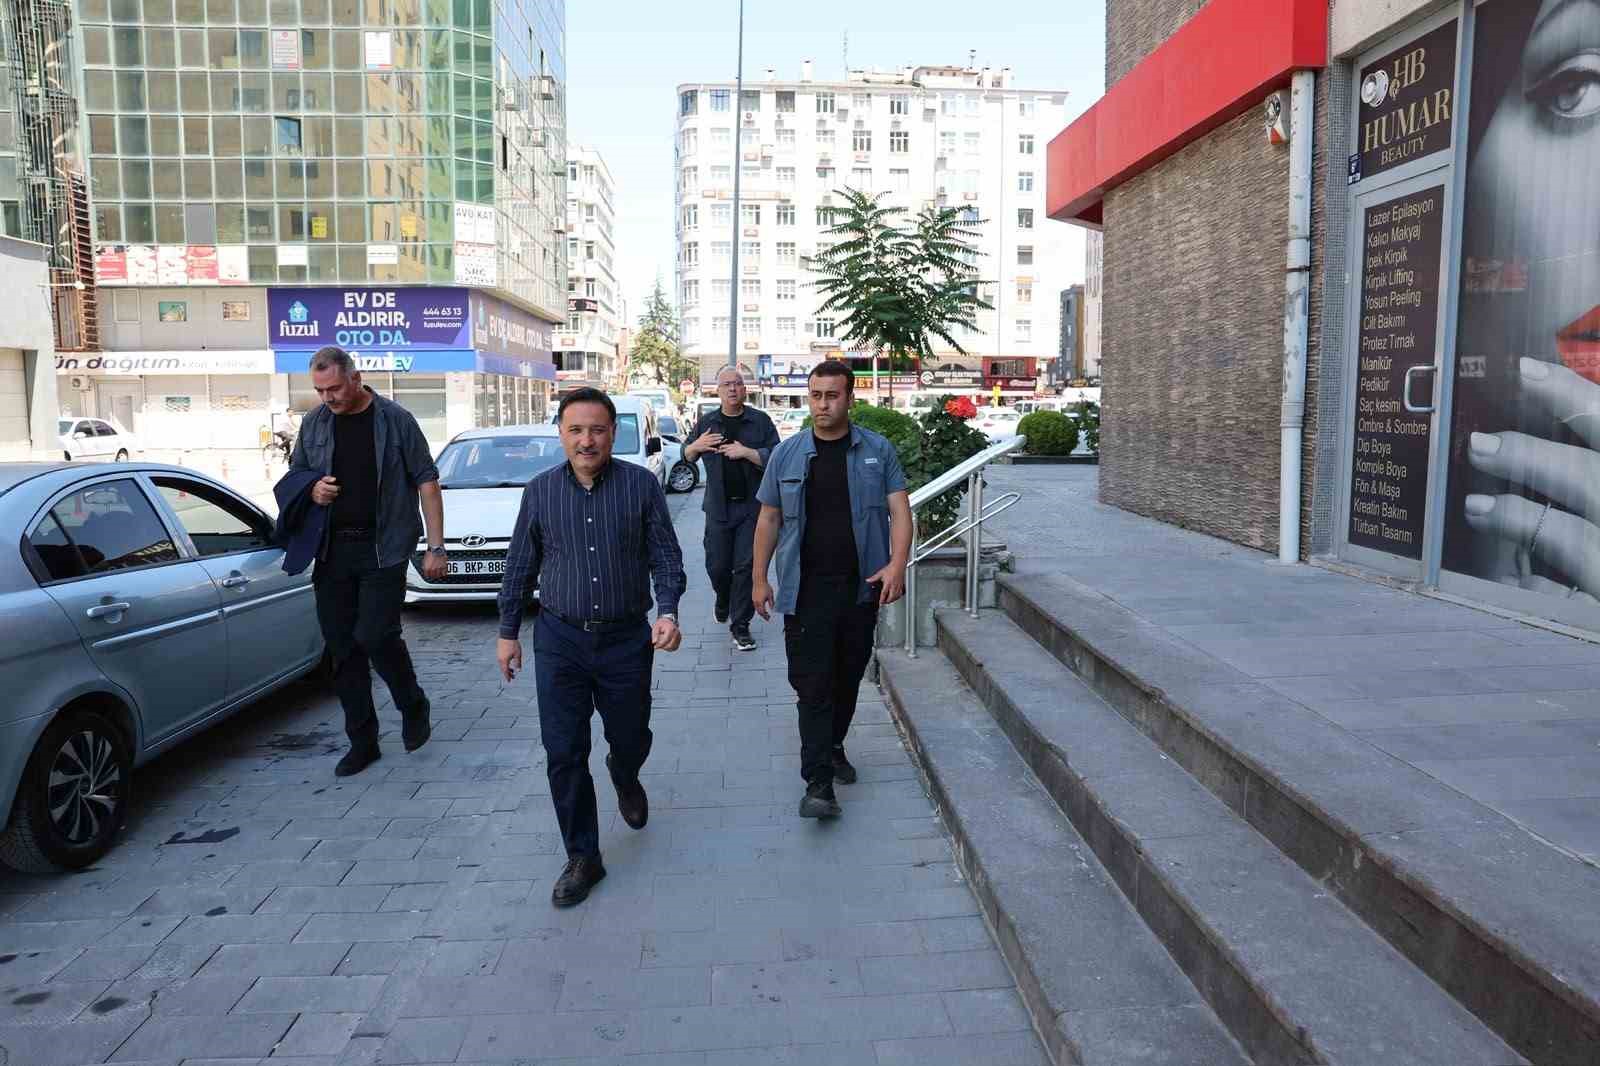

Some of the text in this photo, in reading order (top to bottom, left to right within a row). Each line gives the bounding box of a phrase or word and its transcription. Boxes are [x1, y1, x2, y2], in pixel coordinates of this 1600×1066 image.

[1393, 48, 1425, 88] HB
[1363, 88, 1451, 153] HUMAR
[1381, 134, 1427, 166] BEAUTY
[1368, 198, 1434, 228] Lazer Epilasyon
[1391, 222, 1421, 243] Makyaj
[1389, 268, 1414, 286] Lifting
[344, 292, 396, 308] EV DE
[1390, 288, 1422, 308] Peeling
[334, 311, 411, 329] ALDIRIR,
[423, 307, 462, 316] 444 63 13
[279, 320, 320, 337] fuzul
[335, 331, 412, 346] OTO DA.
[1361, 355, 1393, 370] Manikür
[1360, 376, 1390, 392] Pedikür
[1359, 397, 1375, 416] Saç
[1358, 417, 1427, 435] Ombre & Sombre
[1371, 438, 1391, 458] Boya
[1355, 457, 1407, 481] Komple Boya
[1371, 479, 1377, 494] &
[464, 561, 483, 573] BKP
